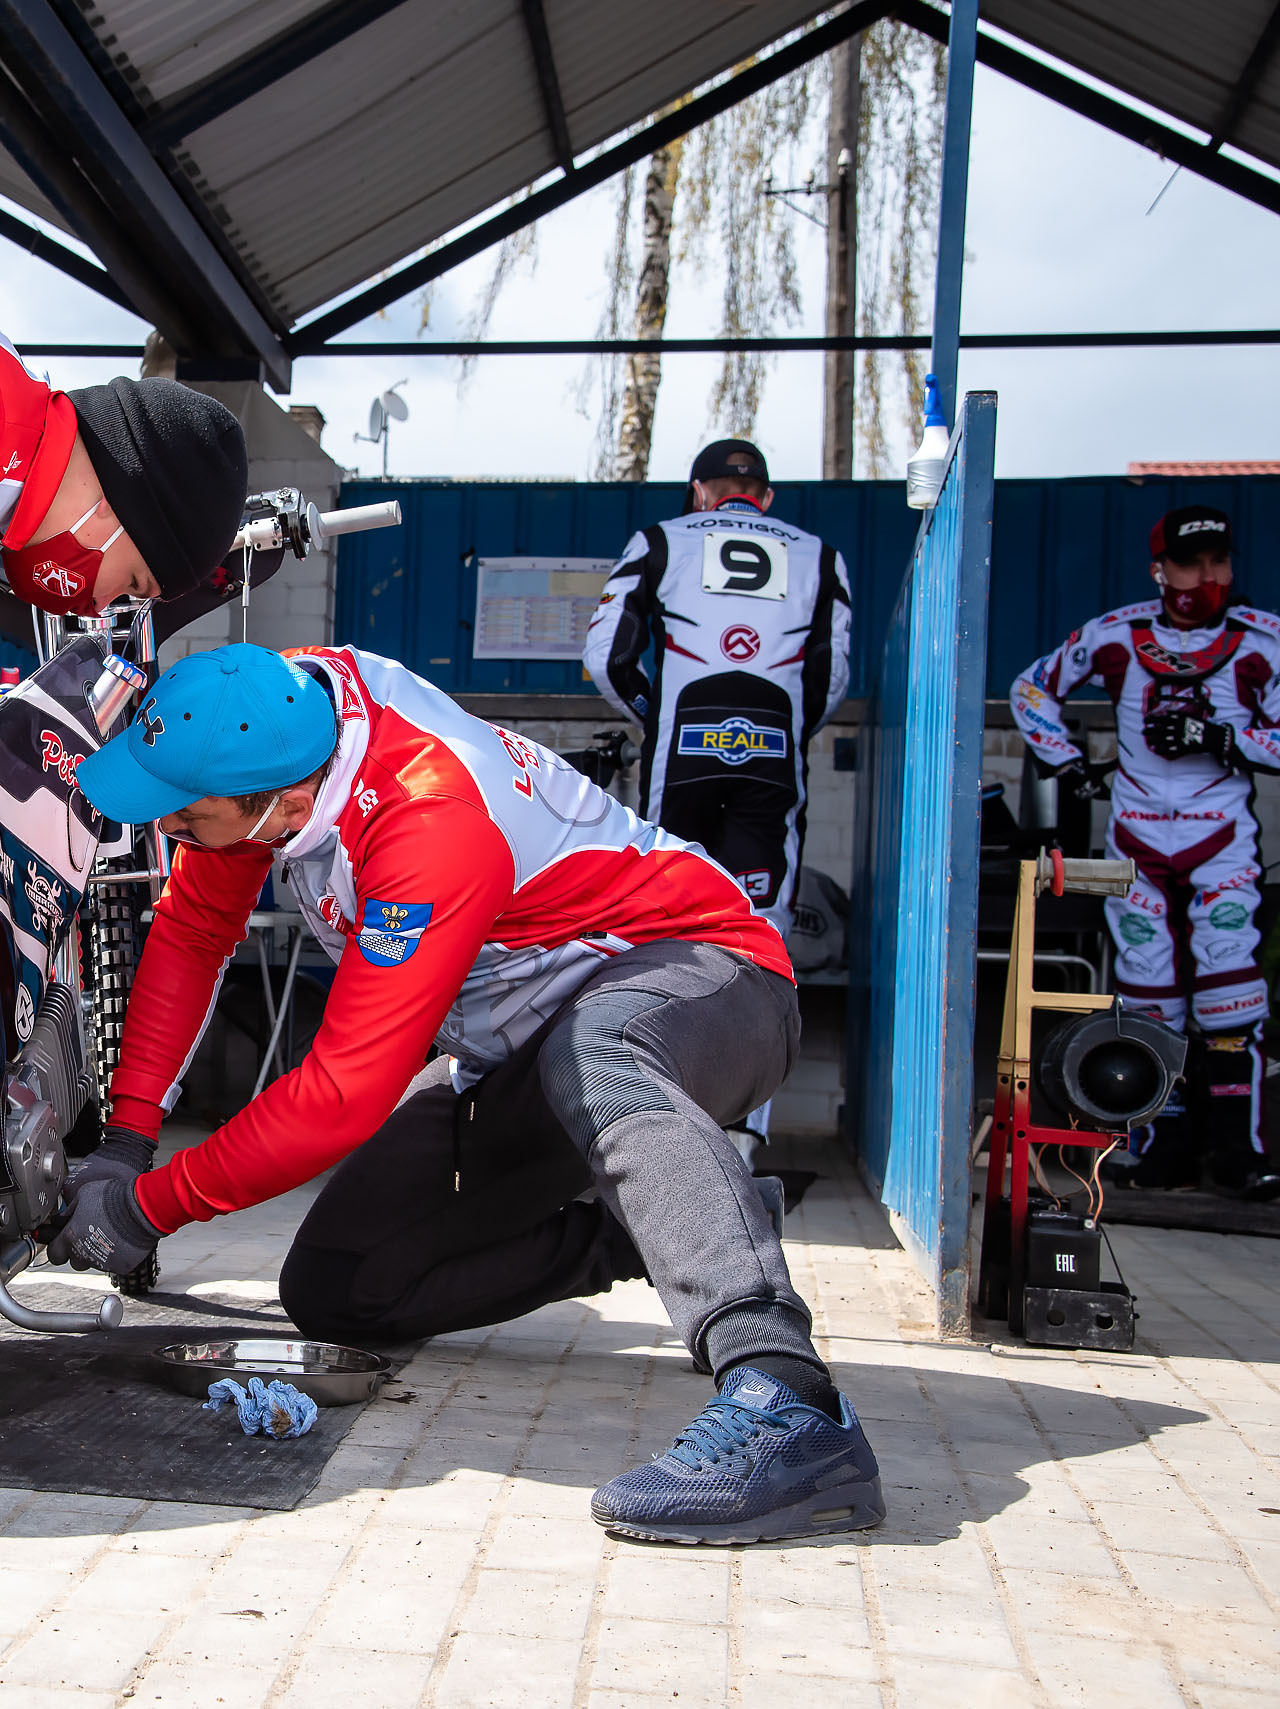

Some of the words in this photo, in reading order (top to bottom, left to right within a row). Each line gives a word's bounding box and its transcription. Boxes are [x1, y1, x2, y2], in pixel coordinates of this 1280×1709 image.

[686, 519, 801, 541] KOSTIGOV
[720, 539, 772, 591] 9
[702, 731, 769, 749] REALL
[1125, 891, 1164, 916] ELS
[1055, 1253, 1076, 1273] EAC
